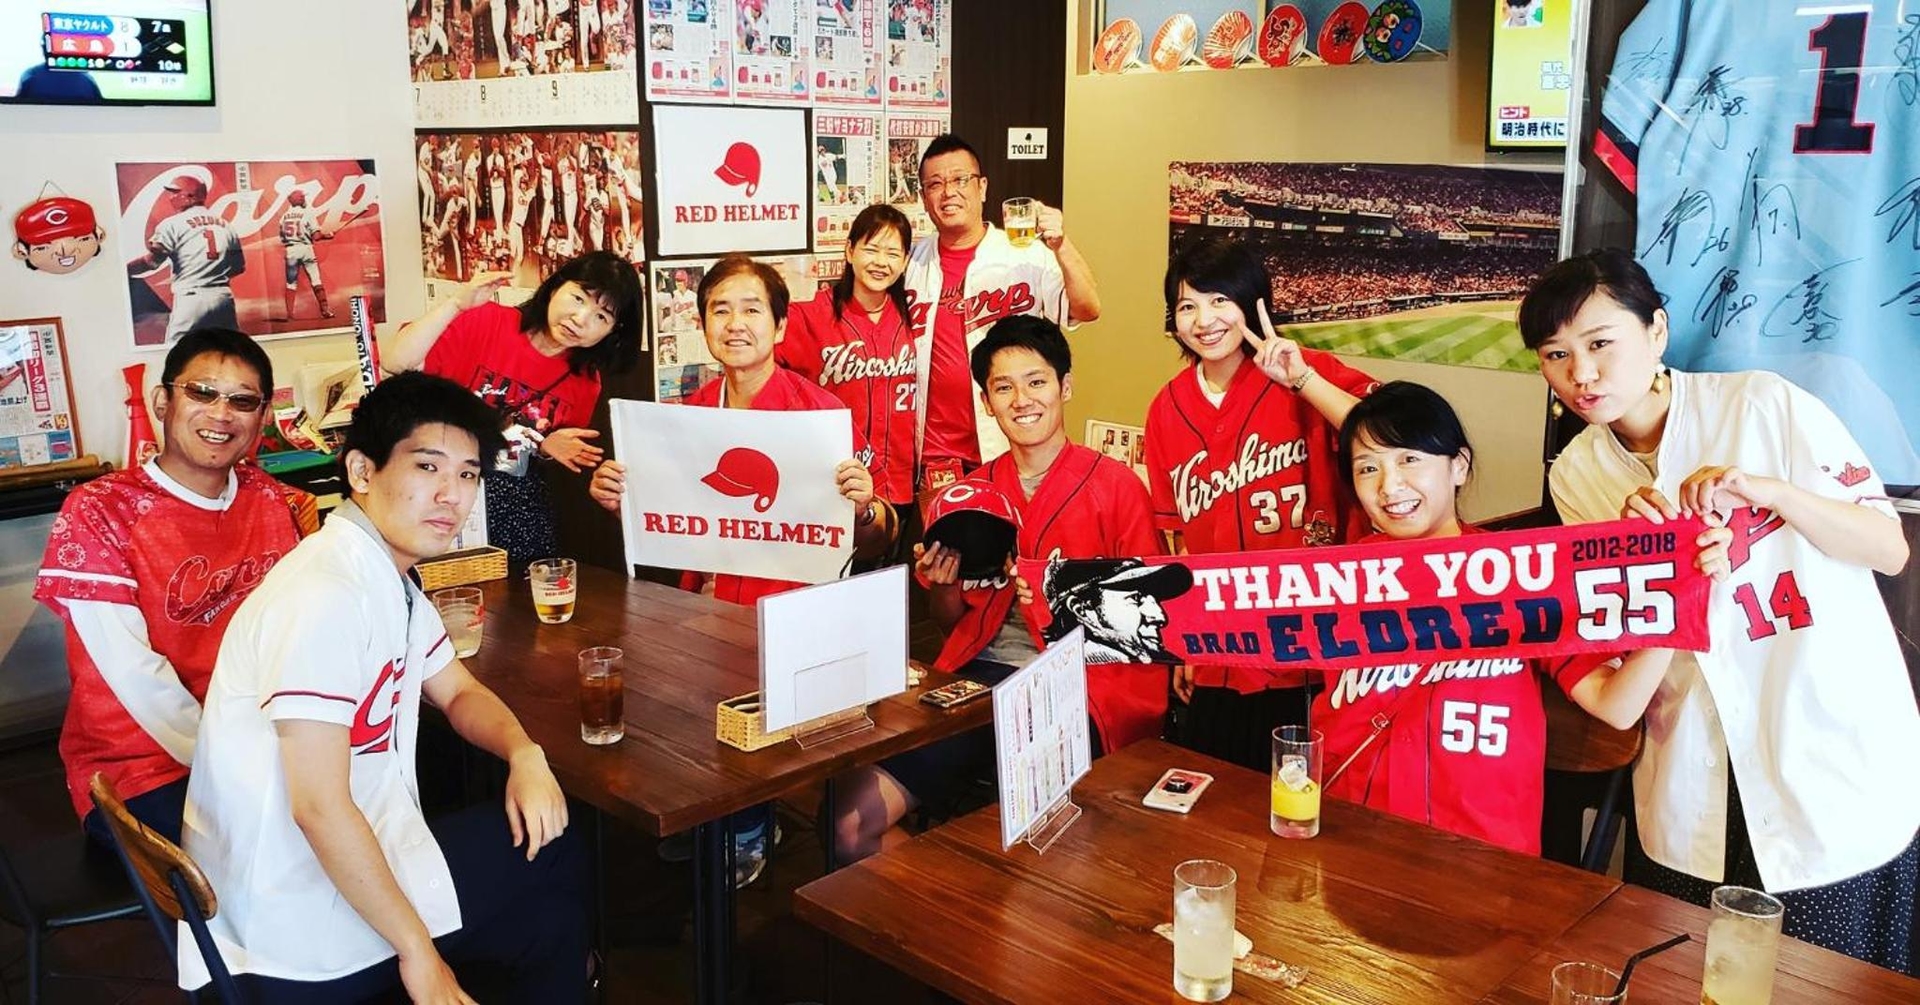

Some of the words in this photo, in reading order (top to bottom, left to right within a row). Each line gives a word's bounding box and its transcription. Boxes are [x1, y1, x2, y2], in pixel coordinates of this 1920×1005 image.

[1793, 11, 1875, 154] 1
[1011, 144, 1044, 154] TOILET
[1502, 121, 1565, 137] 明治時代に
[675, 205, 718, 224] RED
[723, 204, 800, 222] HELMET
[203, 229, 220, 260] 1
[1170, 433, 1308, 523] Hiroshima
[643, 512, 709, 536] RED
[718, 518, 846, 549] HELMET
[1250, 484, 1307, 534] 37
[1572, 532, 1676, 562] 2012-2018
[1193, 557, 1409, 611] THANK
[1423, 542, 1557, 598] YOU
[1574, 561, 1677, 642] 55
[1733, 570, 1815, 641] 14
[1183, 632, 1261, 654] BRAD
[1267, 605, 1562, 662] ELDRED
[1441, 700, 1510, 757] 55
